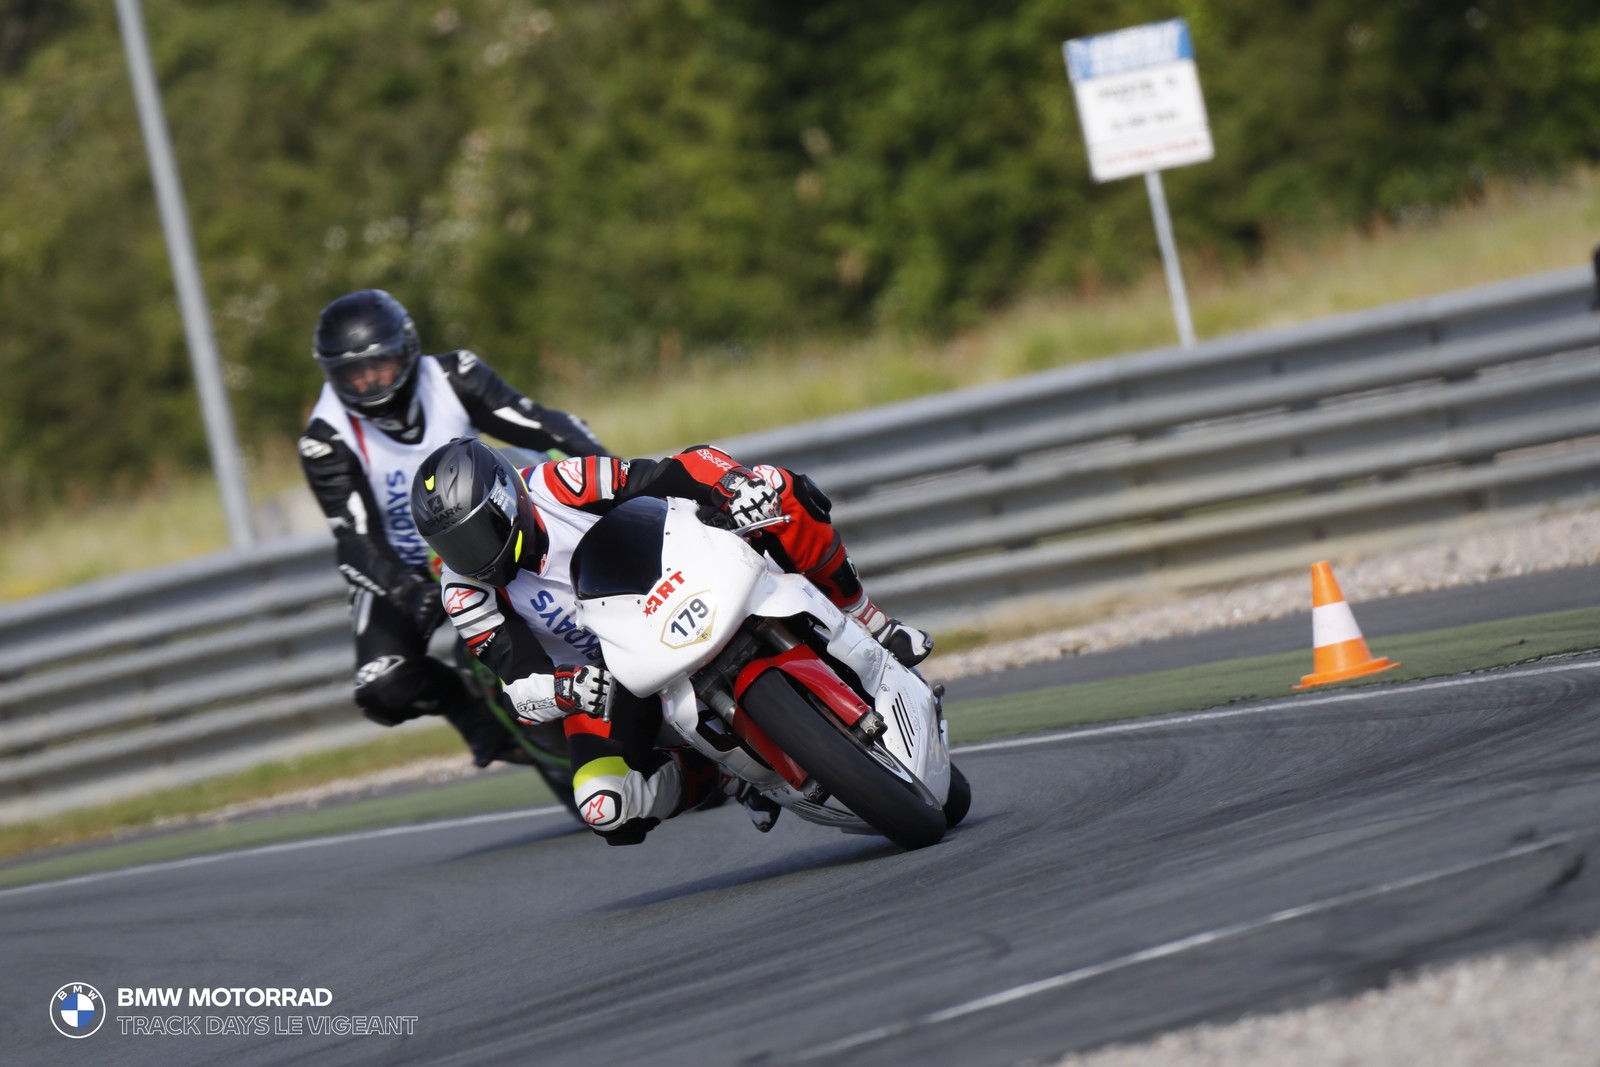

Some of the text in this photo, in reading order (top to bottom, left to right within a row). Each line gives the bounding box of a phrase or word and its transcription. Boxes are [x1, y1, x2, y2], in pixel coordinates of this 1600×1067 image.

[424, 503, 463, 527] SHARK
[646, 570, 685, 613] ART
[671, 598, 709, 637] 179
